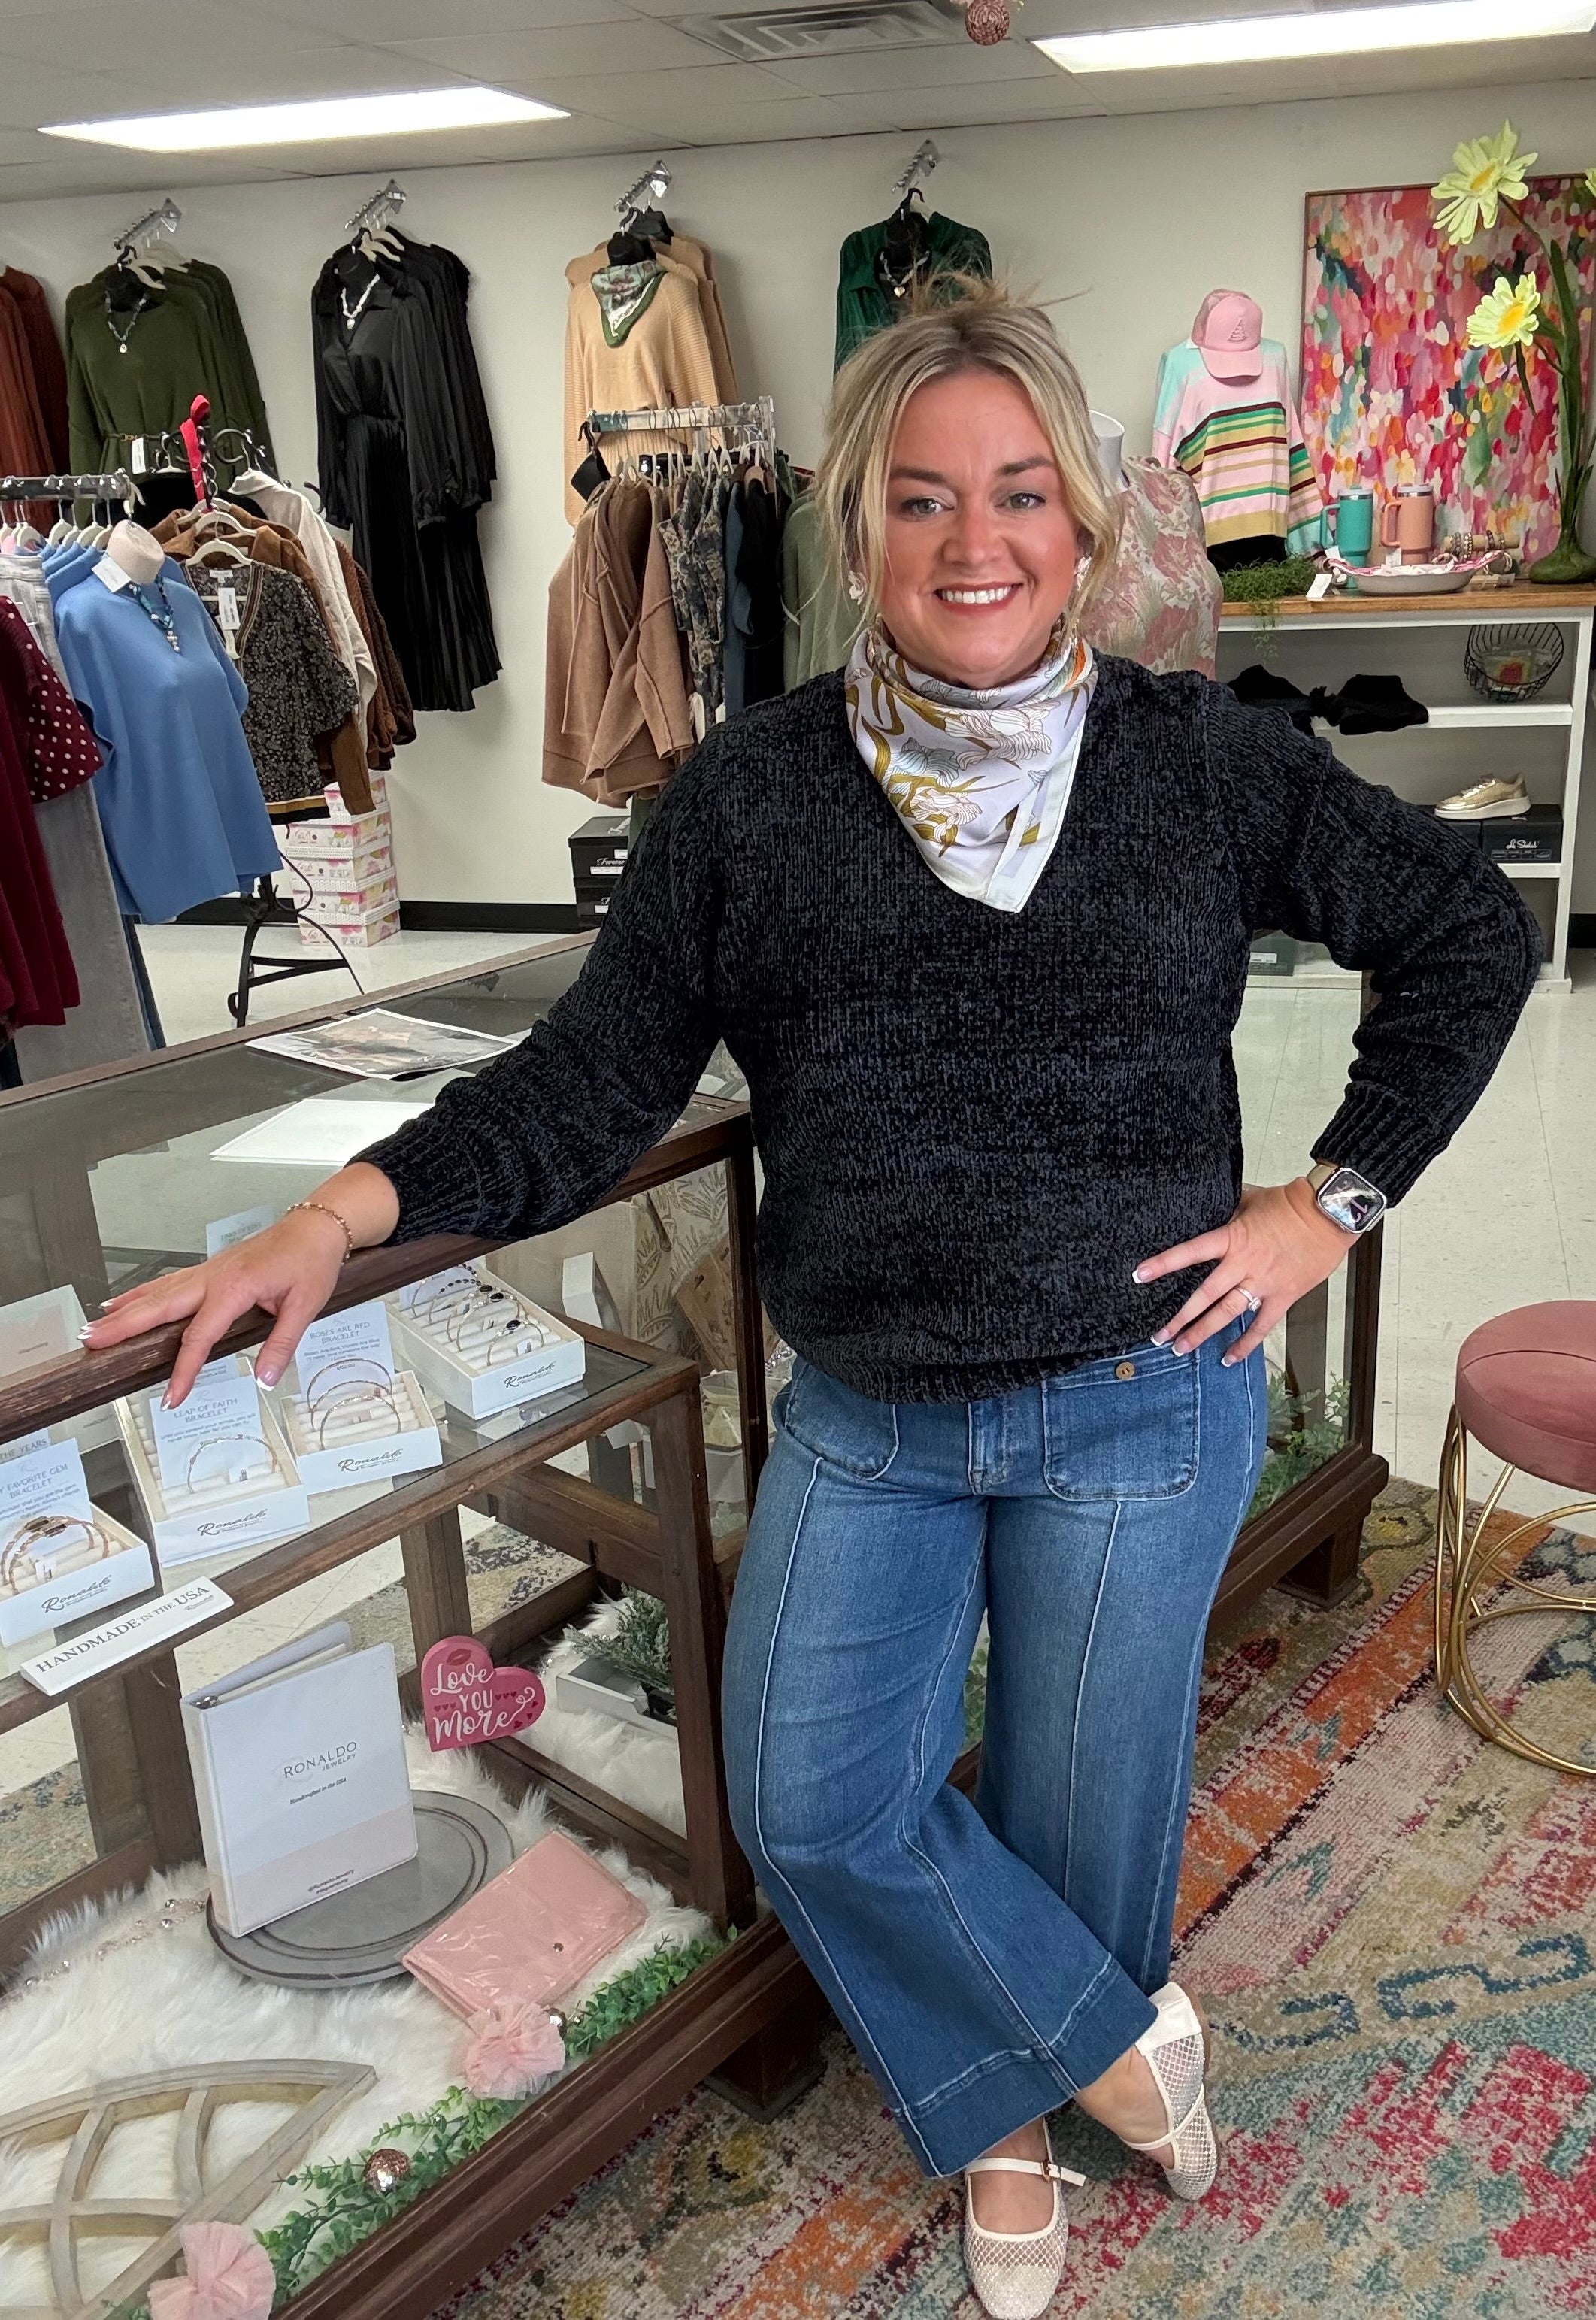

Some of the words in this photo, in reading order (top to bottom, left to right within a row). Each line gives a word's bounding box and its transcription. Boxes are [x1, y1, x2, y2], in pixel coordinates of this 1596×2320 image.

[310, 1328, 335, 1339] ROSES
[354, 1322, 370, 1331] RED
[322, 1330, 360, 1344] BRACELET
[174, 1407, 195, 1419] LEAP
[198, 1404, 210, 1412] OF
[212, 1398, 238, 1408] FAITH
[185, 1407, 228, 1423] BRACELET
[20, 1437, 47, 1453] YEARS
[7, 1470, 47, 1490] FAVORITE
[50, 1464, 68, 1476] GEM
[10, 1478, 53, 1499] BRACELET
[36, 1618, 141, 1673] HANDMADE
[140, 1613, 153, 1622] IN
[152, 1602, 177, 1615] THE
[174, 1587, 210, 1605] USA
[429, 1662, 495, 1696] Love
[459, 1689, 493, 1713] YOU
[432, 1702, 528, 1745] More
[283, 1741, 357, 1779] RONALDO
[322, 1753, 356, 1771] JEWELRY
